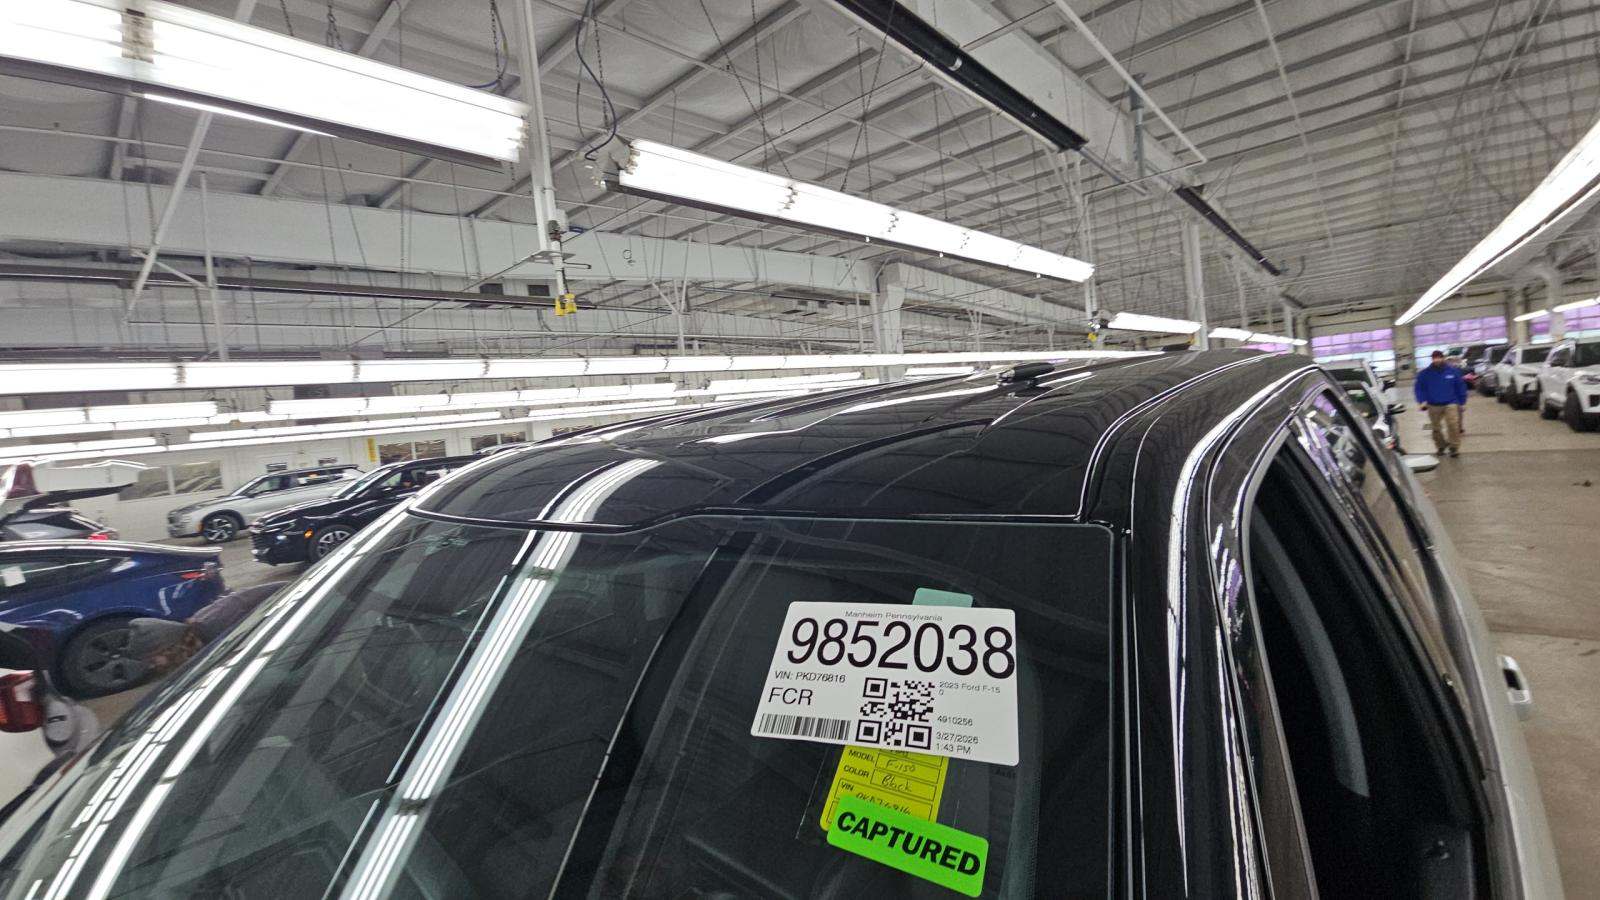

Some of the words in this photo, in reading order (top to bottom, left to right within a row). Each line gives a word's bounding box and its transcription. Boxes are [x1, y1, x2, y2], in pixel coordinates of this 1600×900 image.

[845, 610, 883, 618] Manheim
[885, 612, 943, 621] Pennsylvania
[787, 617, 1015, 679] 9852038
[775, 671, 793, 680] VIN:
[795, 671, 846, 683] PKD76816
[939, 681, 959, 689] 2023
[961, 683, 980, 691] Ford
[983, 685, 1001, 693] F-15
[768, 687, 813, 706] FCR
[937, 715, 973, 726] 4910256
[936, 743, 954, 752] 1:43
[957, 745, 971, 754] PM
[848, 749, 874, 761] MODEL
[843, 765, 870, 778] COLOR
[841, 781, 854, 791] VIN
[837, 812, 981, 876] CAPTURED
